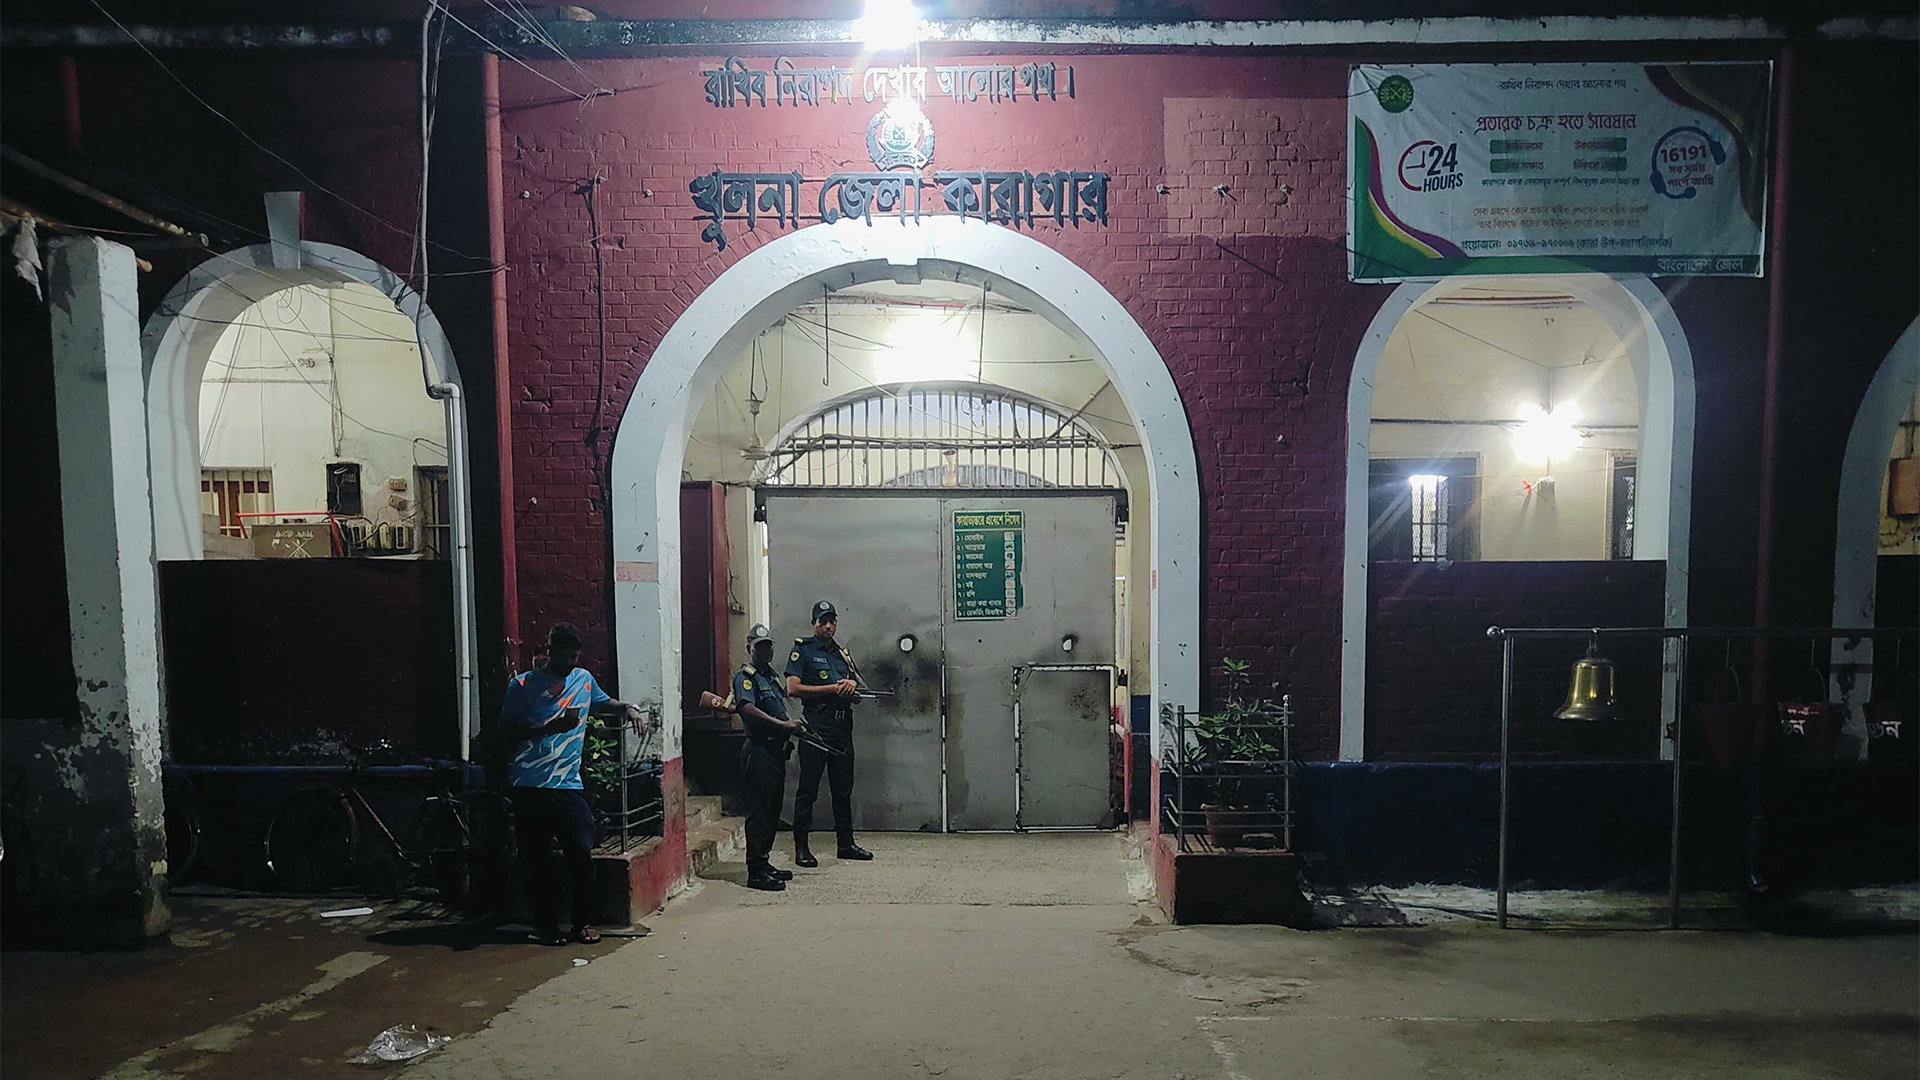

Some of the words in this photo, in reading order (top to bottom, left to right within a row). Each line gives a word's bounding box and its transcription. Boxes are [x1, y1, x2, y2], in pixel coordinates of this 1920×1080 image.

[704, 54, 767, 107] রাখিব
[773, 55, 854, 106] নিরাপদ
[935, 62, 1016, 104] আলোর
[1474, 116, 1522, 135] প্রতারক
[1528, 116, 1552, 132] চক্র
[1557, 115, 1584, 130] হতে
[1587, 112, 1637, 129] সাবধান
[1427, 142, 1458, 176] 24
[1660, 144, 1707, 163] 16191
[1423, 172, 1464, 192] HOURS
[690, 169, 803, 252] খুলনা
[820, 170, 923, 228] জেলা
[940, 169, 1111, 230] কারাগার
[1657, 258, 1713, 272] বাংলাদেশ
[1715, 258, 1744, 271] জেল
